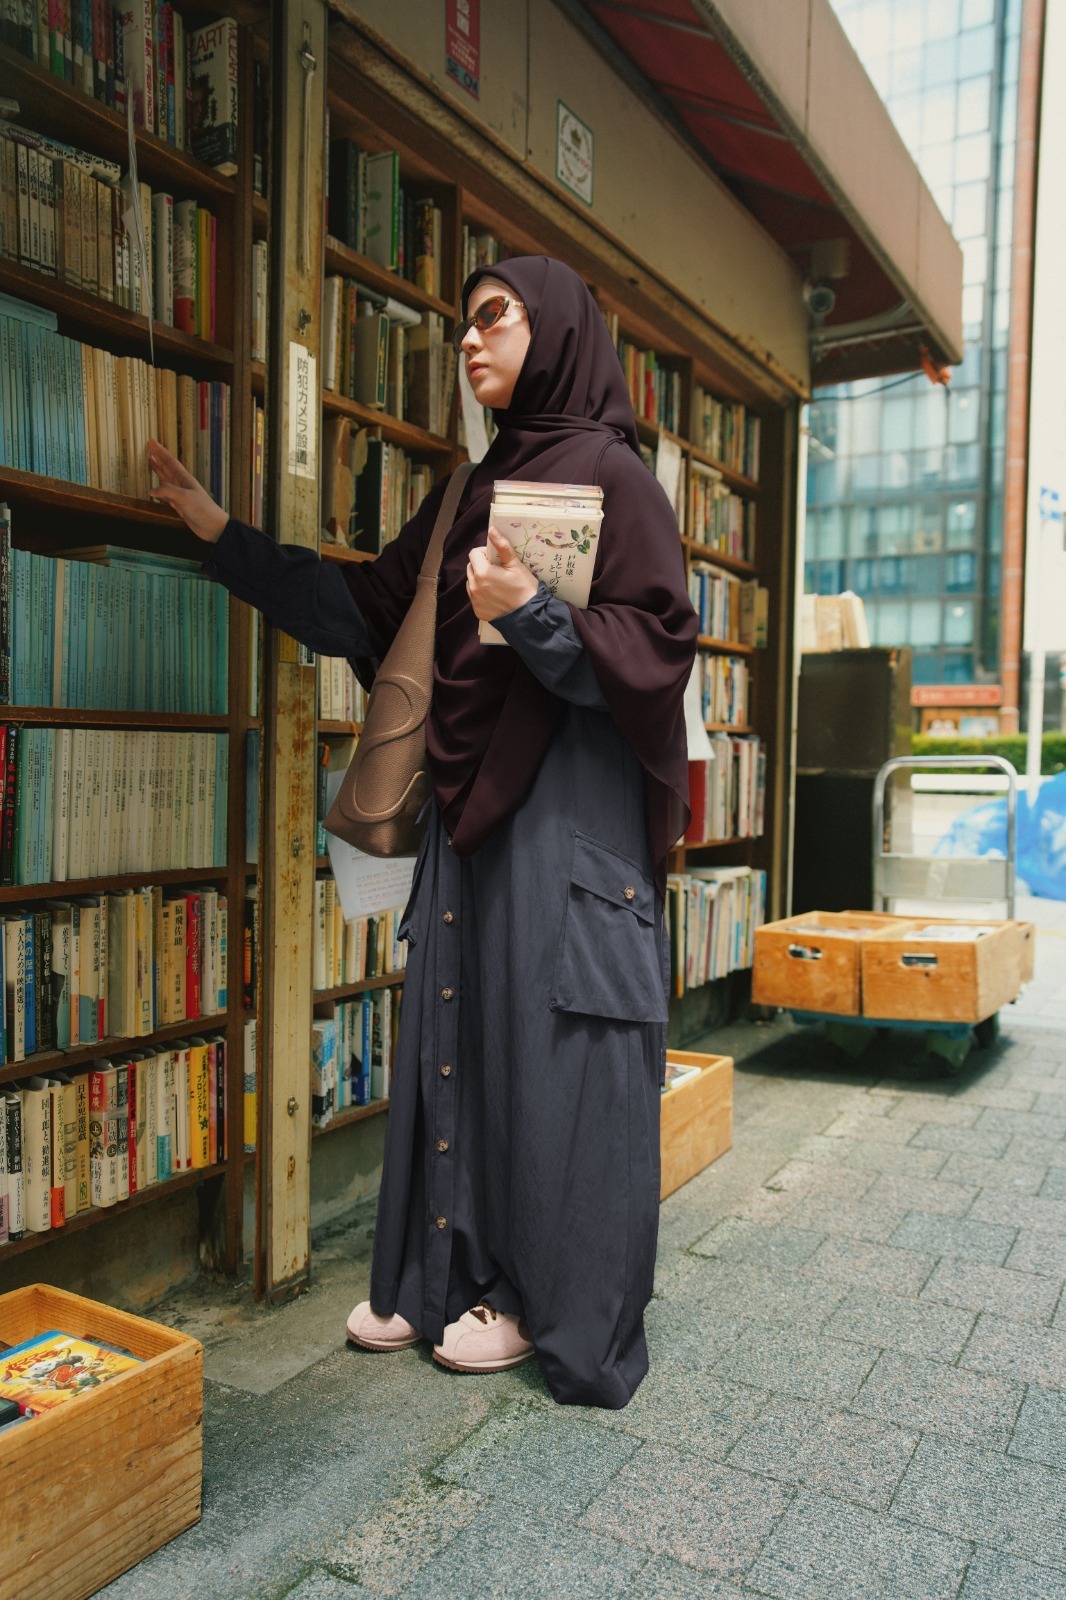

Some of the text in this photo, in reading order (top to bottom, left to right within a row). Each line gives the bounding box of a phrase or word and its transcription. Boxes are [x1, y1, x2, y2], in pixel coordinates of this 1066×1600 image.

[297, 357, 308, 466] 防犯カメラ設置
[174, 905, 183, 947] 猿飛佐助
[78, 1084, 87, 1141] 日本の児童遊戯
